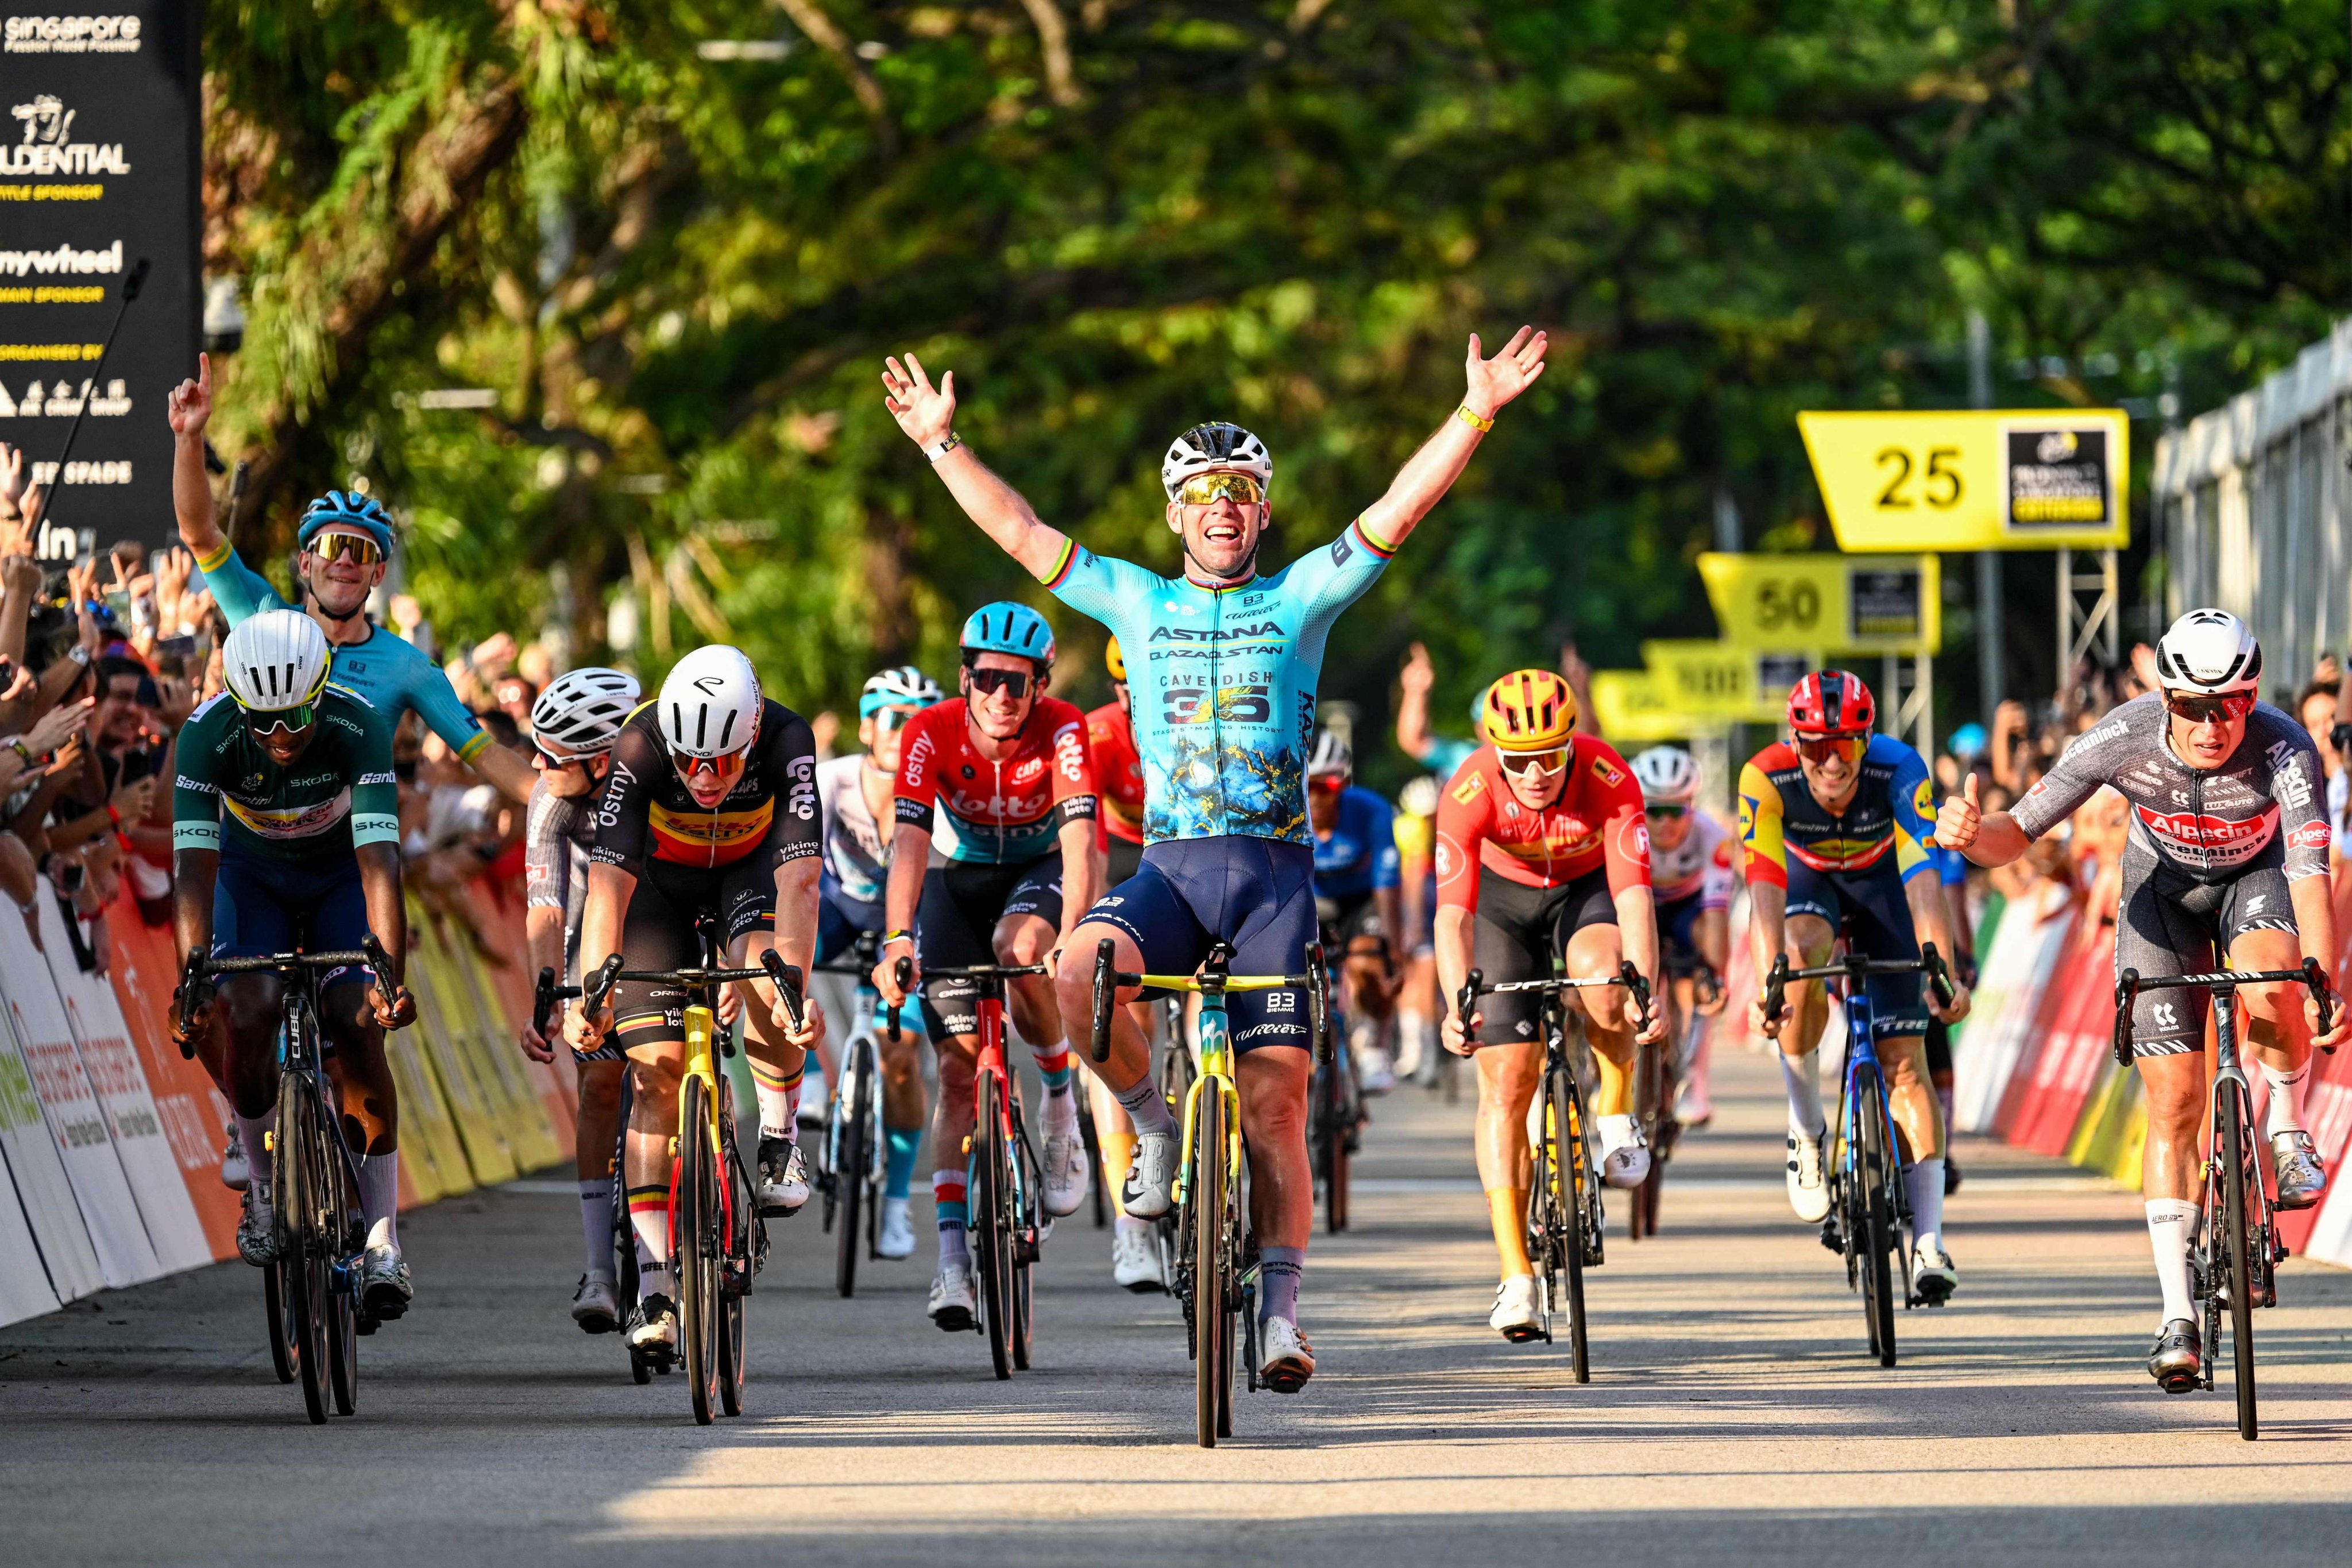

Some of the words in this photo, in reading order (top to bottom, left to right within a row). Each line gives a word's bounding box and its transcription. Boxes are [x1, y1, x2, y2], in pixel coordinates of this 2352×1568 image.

[0, 240, 123, 277] nywheel
[1876, 449, 1962, 507] 25
[1243, 593, 1264, 605] B3
[1757, 581, 1820, 628] 50
[1225, 601, 1281, 620] Wilier
[1148, 621, 1285, 642] ASTANA
[1149, 646, 1283, 661] QAZAQSTAN
[1160, 671, 1273, 687] CAVENDISH
[1163, 685, 1270, 724] 35
[326, 715, 364, 737] SKODA
[906, 729, 936, 787] dstny
[1015, 756, 1042, 779] CAPS
[291, 773, 340, 787] SKODA
[2265, 740, 2313, 811] Alpecin
[599, 760, 637, 827] dstny
[1063, 796, 1095, 808] viking
[2152, 816, 2252, 839] Alpecin
[779, 841, 818, 855] viking
[783, 849, 815, 862] lotto
[2183, 972, 2263, 983] CANYON
[1267, 992, 1295, 1007] B3
[289, 1007, 301, 1059] CUBE
[1236, 1024, 1307, 1041] Wilier
[764, 1125, 793, 1134] DEFEET
[640, 1262, 669, 1273] DEFEET
